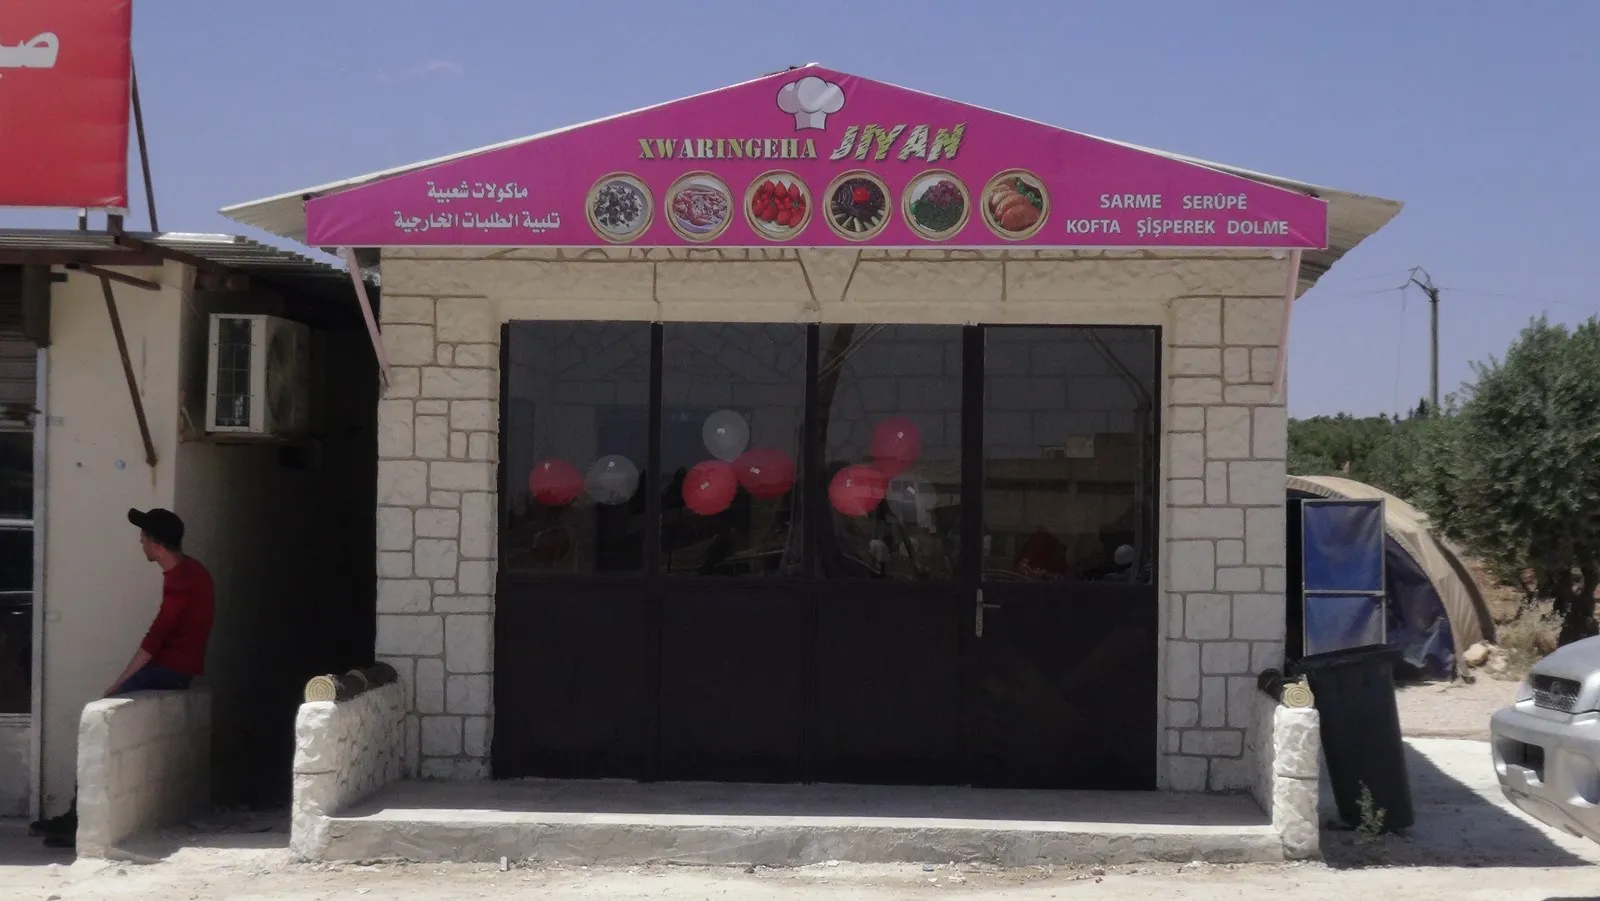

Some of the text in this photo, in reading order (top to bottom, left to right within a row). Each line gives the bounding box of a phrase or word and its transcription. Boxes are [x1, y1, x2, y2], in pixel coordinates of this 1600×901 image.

[638, 123, 968, 163] XWARINGEHA JIYAN
[426, 181, 529, 204] مأكولات شعبية
[1100, 193, 1247, 210] SARME SERÛPÊ
[393, 210, 561, 234] تلبية الطلبات الخارجية
[1066, 219, 1121, 234] KOFTA
[1227, 219, 1289, 235] DOLME
